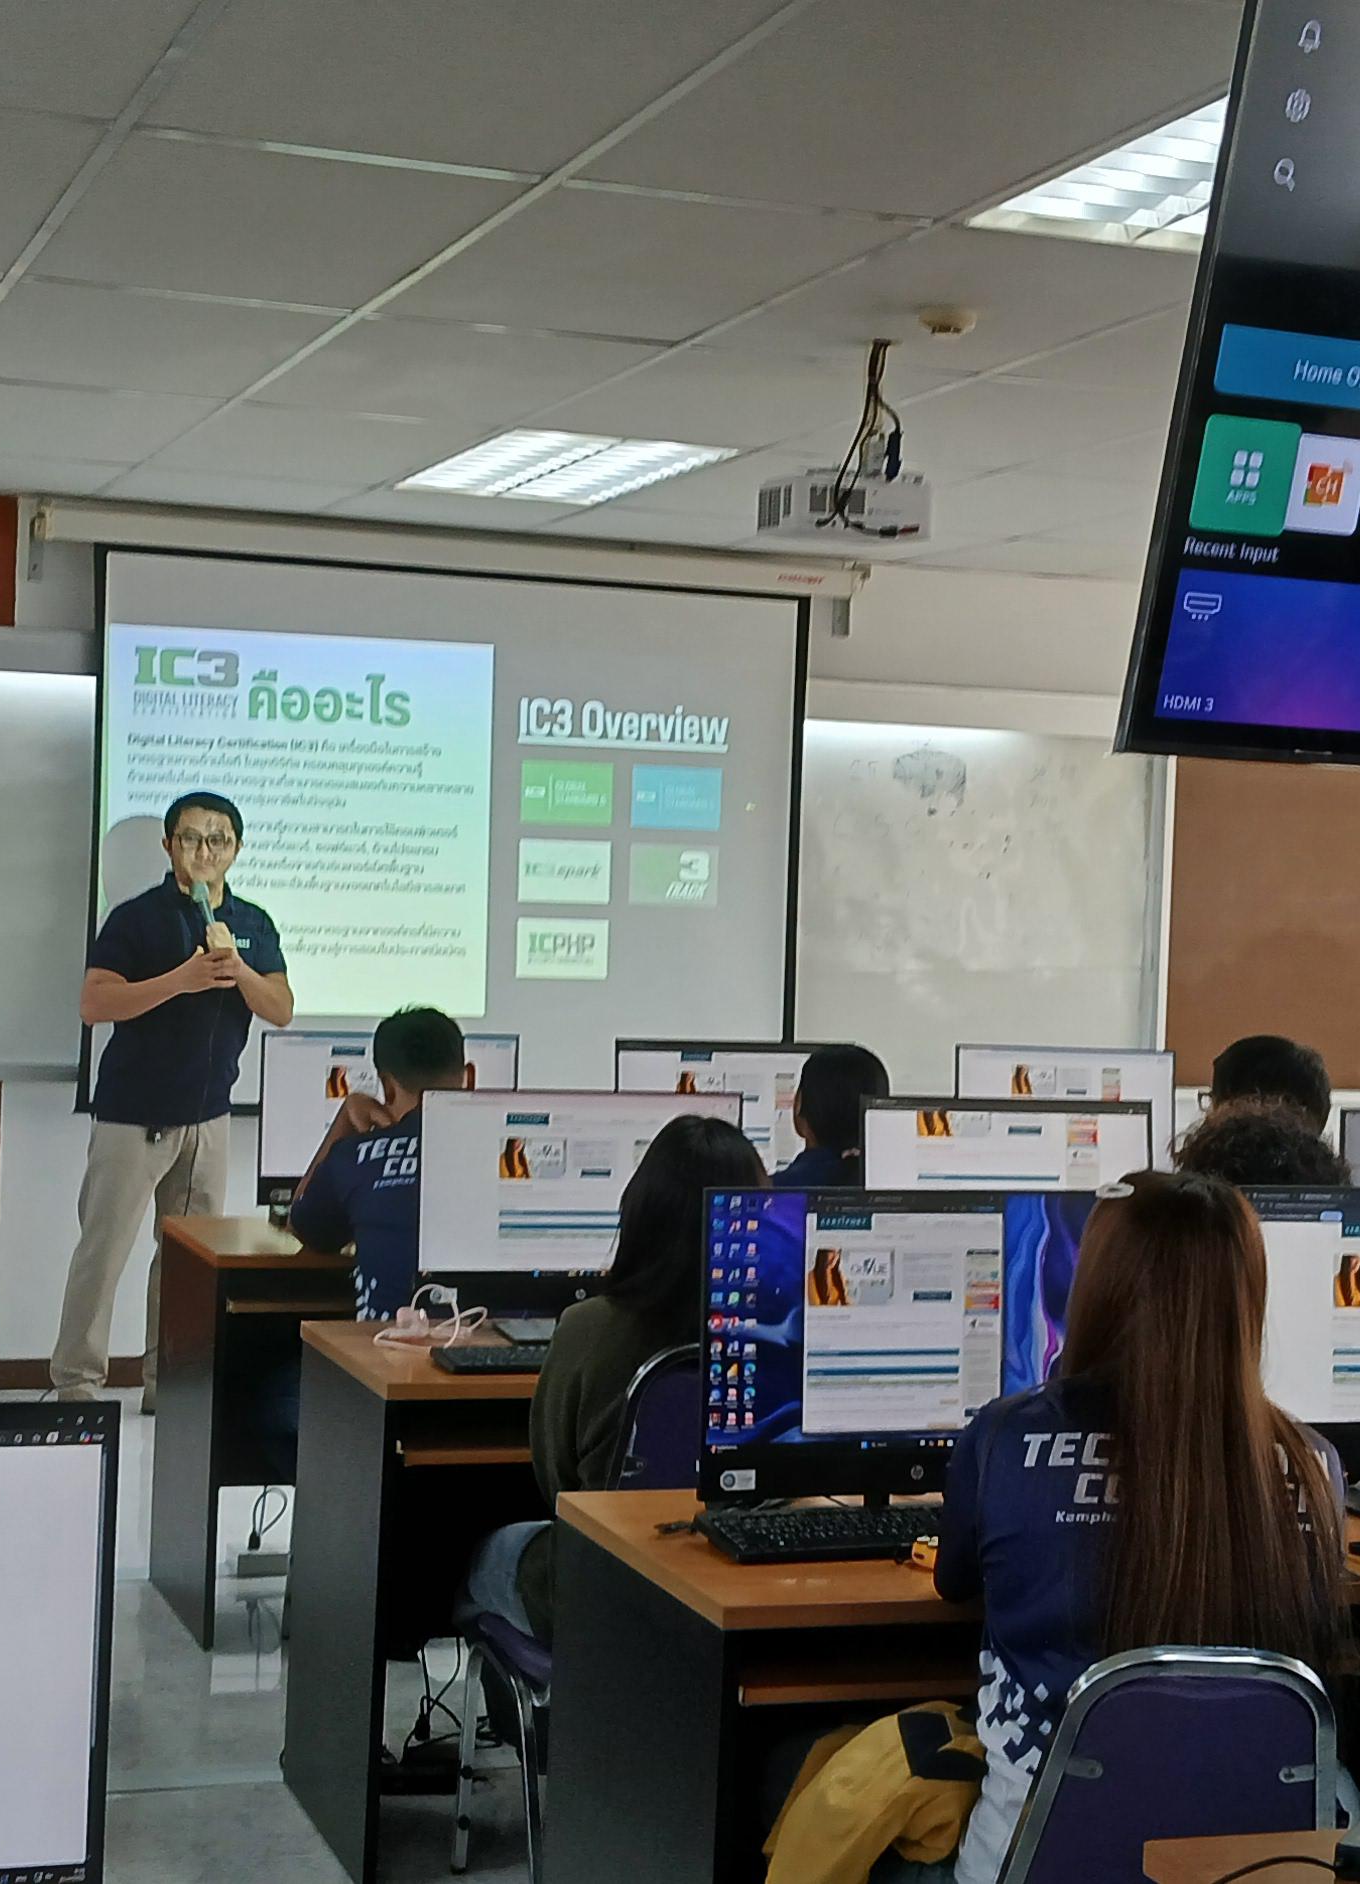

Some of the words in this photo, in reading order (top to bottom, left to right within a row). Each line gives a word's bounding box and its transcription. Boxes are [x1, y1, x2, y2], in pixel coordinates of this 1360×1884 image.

[1293, 358, 1341, 387] Home
[1225, 490, 1257, 507] APPS
[1183, 536, 1237, 560] Recent
[1240, 541, 1281, 564] Input
[134, 645, 240, 687] IC3
[133, 690, 177, 707] DIGITAL
[179, 692, 239, 710] LITERACY
[247, 669, 411, 728] คืออะไร
[1163, 694, 1203, 713] HDMI
[1204, 696, 1215, 713] 3
[518, 696, 573, 738] IC3
[581, 700, 729, 746] Overview
[127, 733, 166, 750] Digital
[167, 734, 214, 751] Literacy
